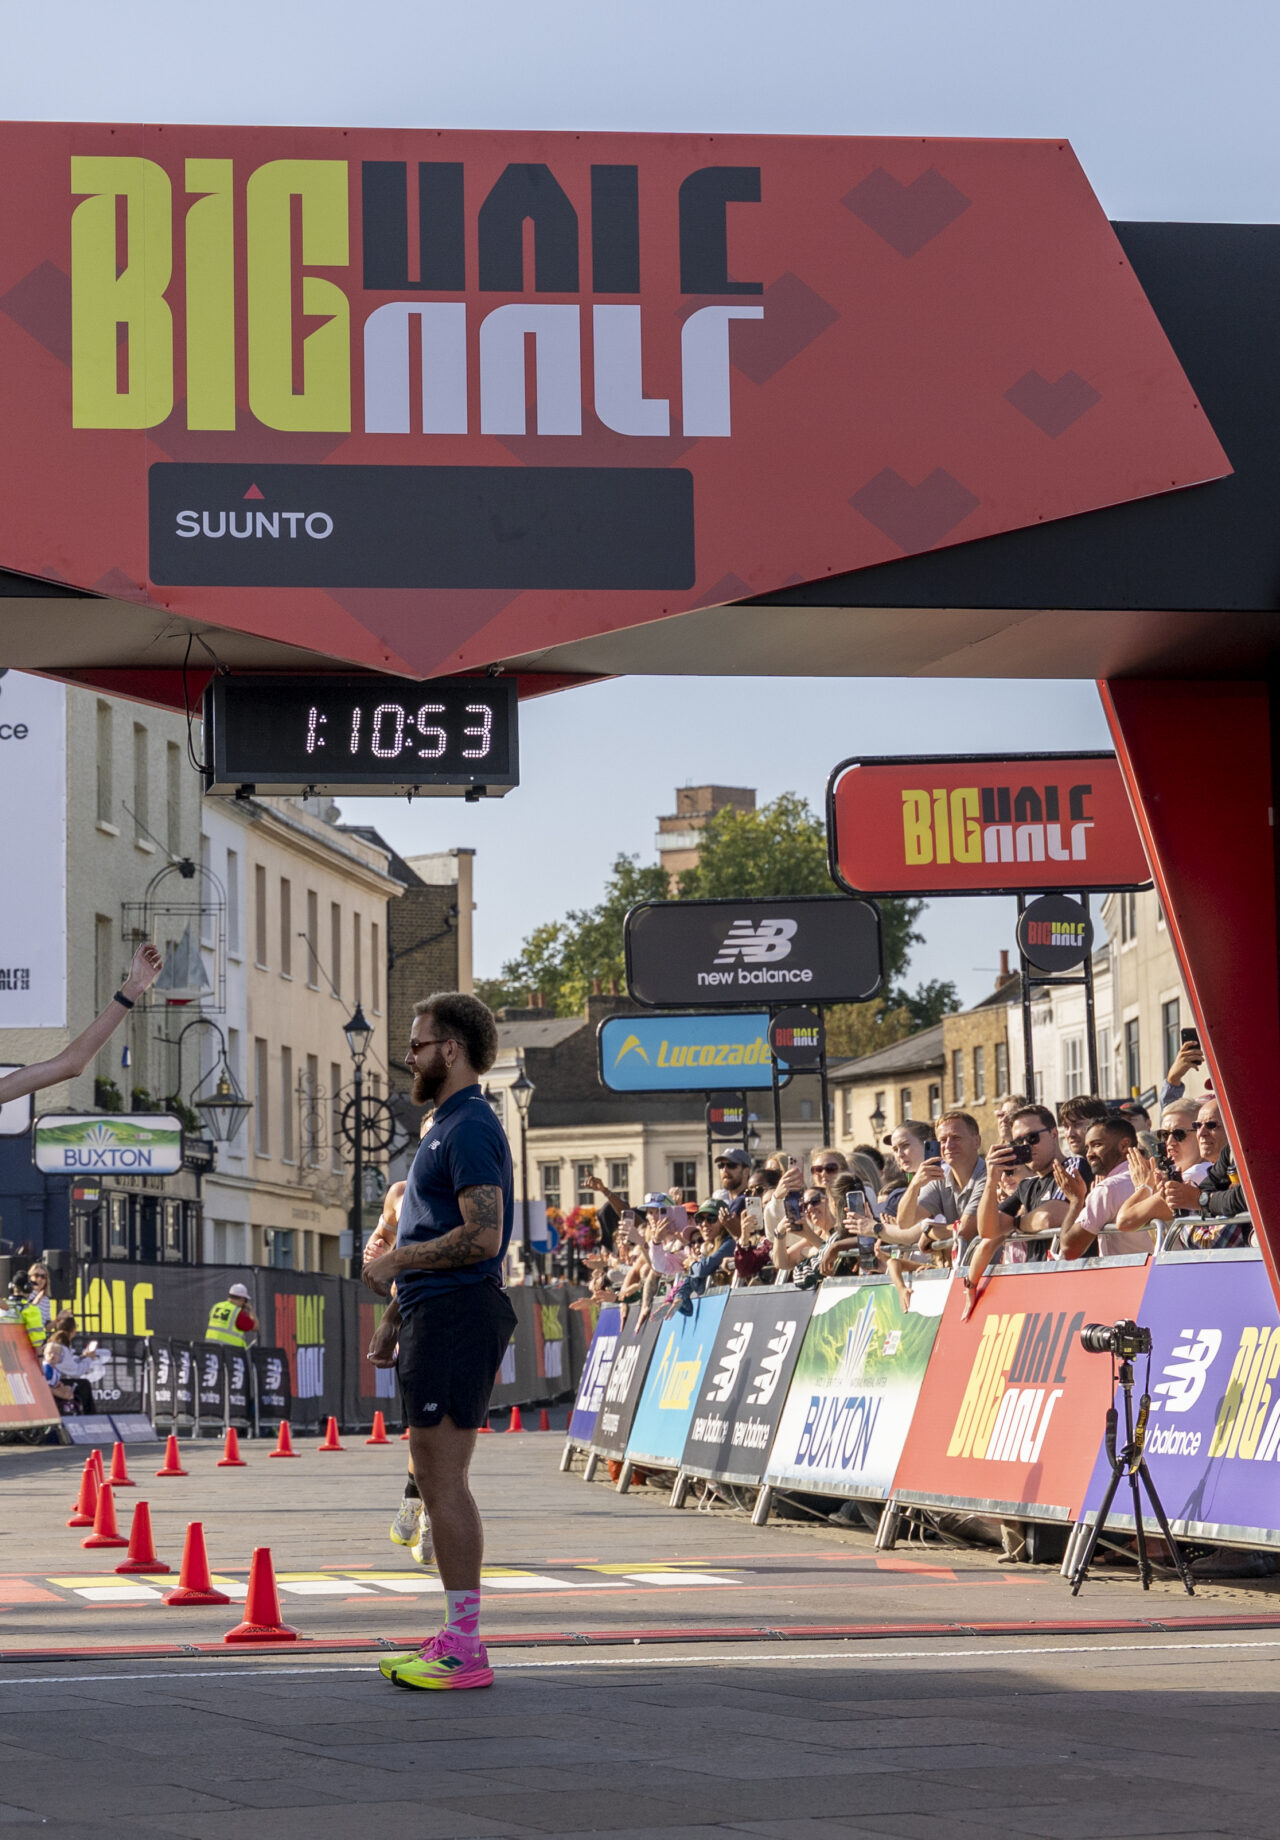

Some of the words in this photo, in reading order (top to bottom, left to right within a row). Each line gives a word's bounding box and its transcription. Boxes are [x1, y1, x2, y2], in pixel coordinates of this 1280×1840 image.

[175, 509, 333, 540] SUUNTO
[306, 704, 493, 758] 1:10:53
[697, 970, 734, 986] new
[738, 966, 813, 985] balance
[657, 1037, 772, 1067] Lucozade
[64, 1149, 152, 1167] BUXTON
[691, 1417, 709, 1442] new
[731, 1421, 749, 1447] new
[743, 1416, 771, 1450] balance
[794, 1395, 882, 1471] BUXTON
[1148, 1423, 1201, 1456] balance
